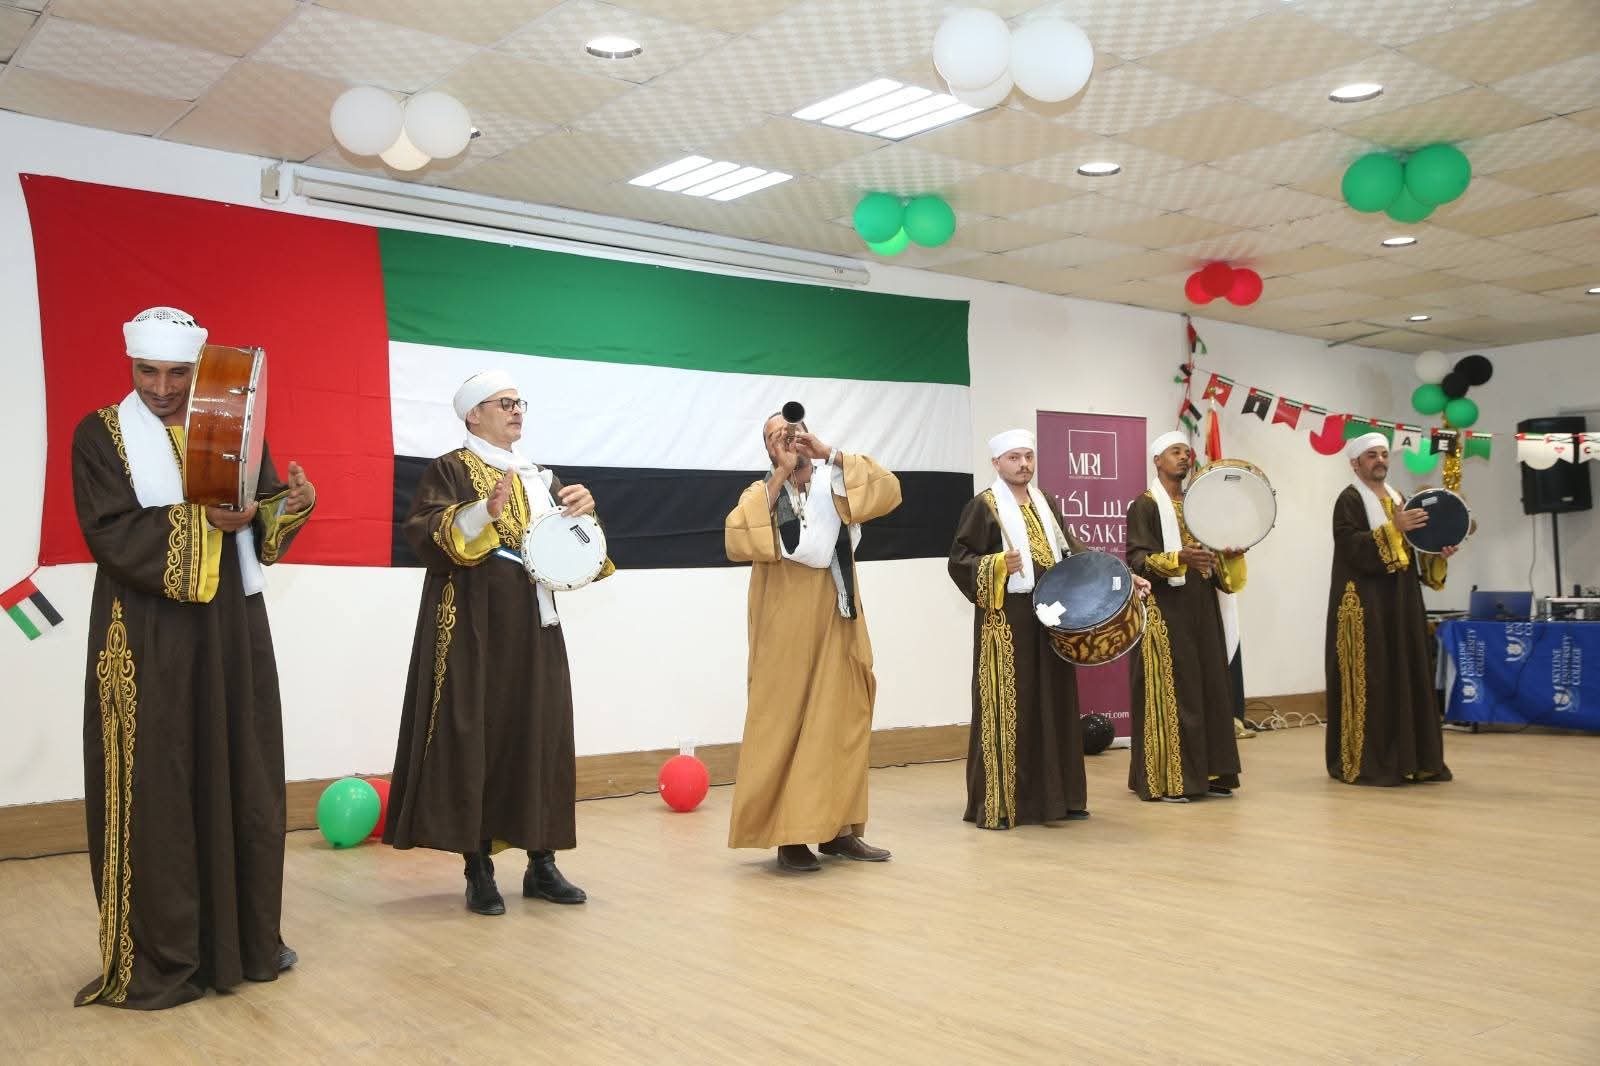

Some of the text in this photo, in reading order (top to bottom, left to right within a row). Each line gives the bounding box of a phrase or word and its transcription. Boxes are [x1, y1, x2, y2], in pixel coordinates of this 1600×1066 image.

[1402, 436, 1411, 447] A
[1438, 439, 1449, 450] E
[1068, 452, 1101, 475] MRI
[1068, 523, 1127, 543] ASAKE
